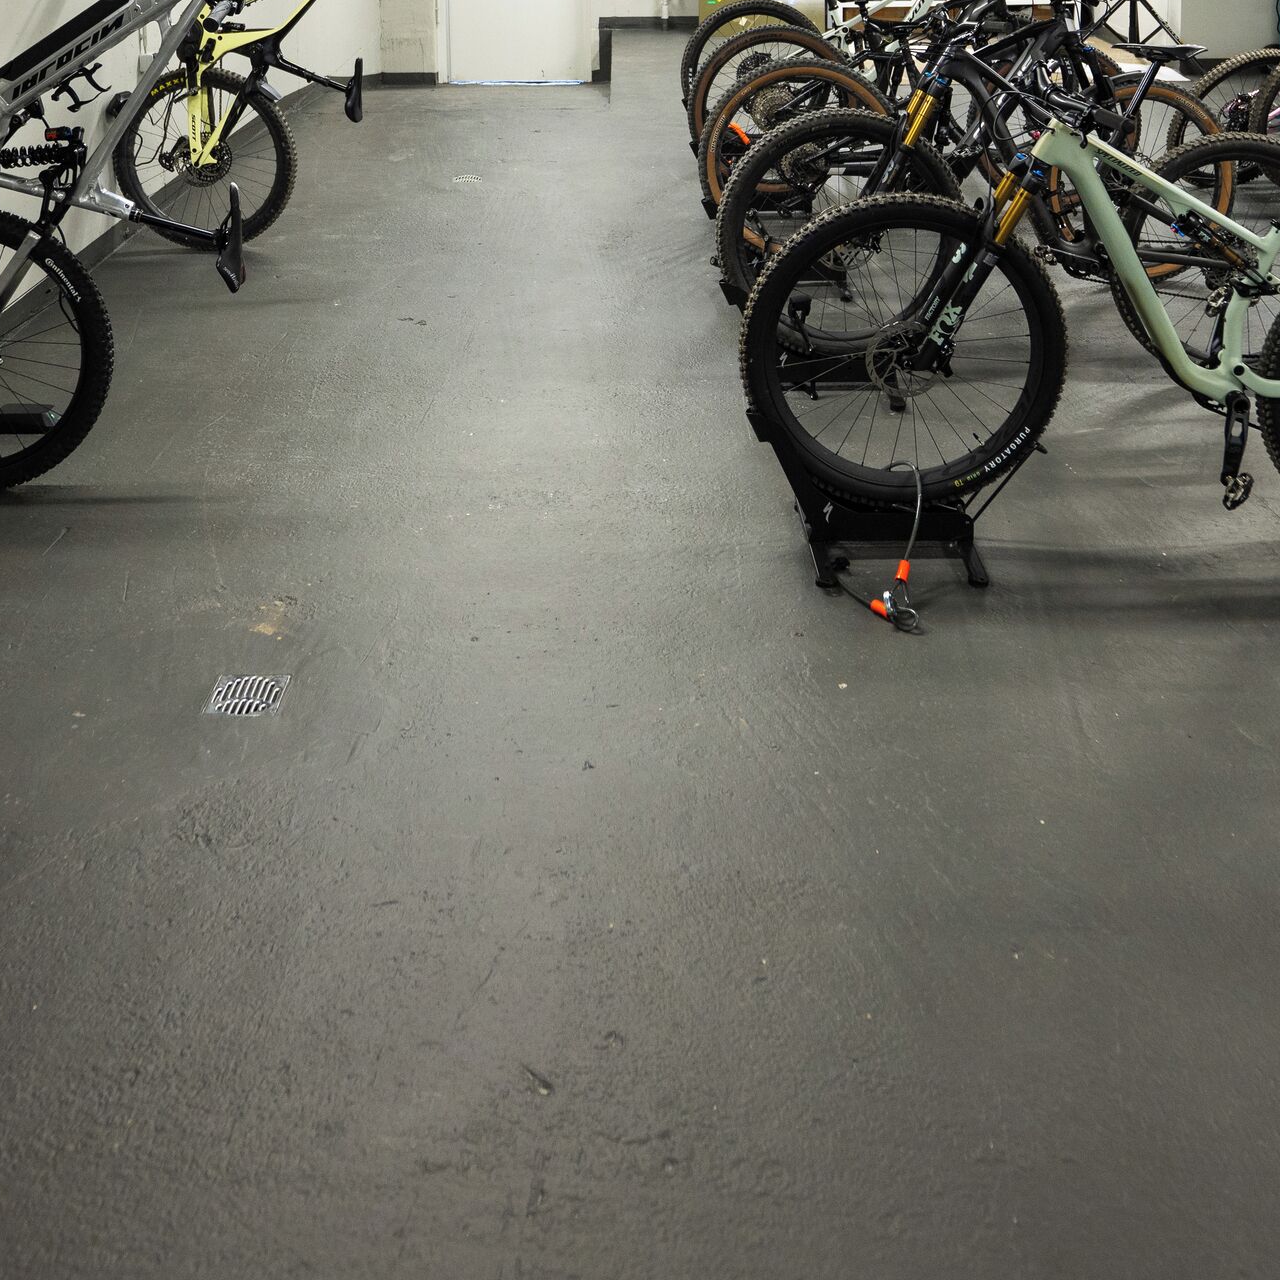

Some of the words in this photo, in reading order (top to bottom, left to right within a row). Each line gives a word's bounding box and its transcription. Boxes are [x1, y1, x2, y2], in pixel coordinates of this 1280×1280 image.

[151, 77, 185, 97] MAXXI
[45, 257, 78, 297] Continental
[924, 295, 941, 321] FACTORY
[928, 300, 963, 347] FOX
[984, 425, 1031, 473] PURGATORY
